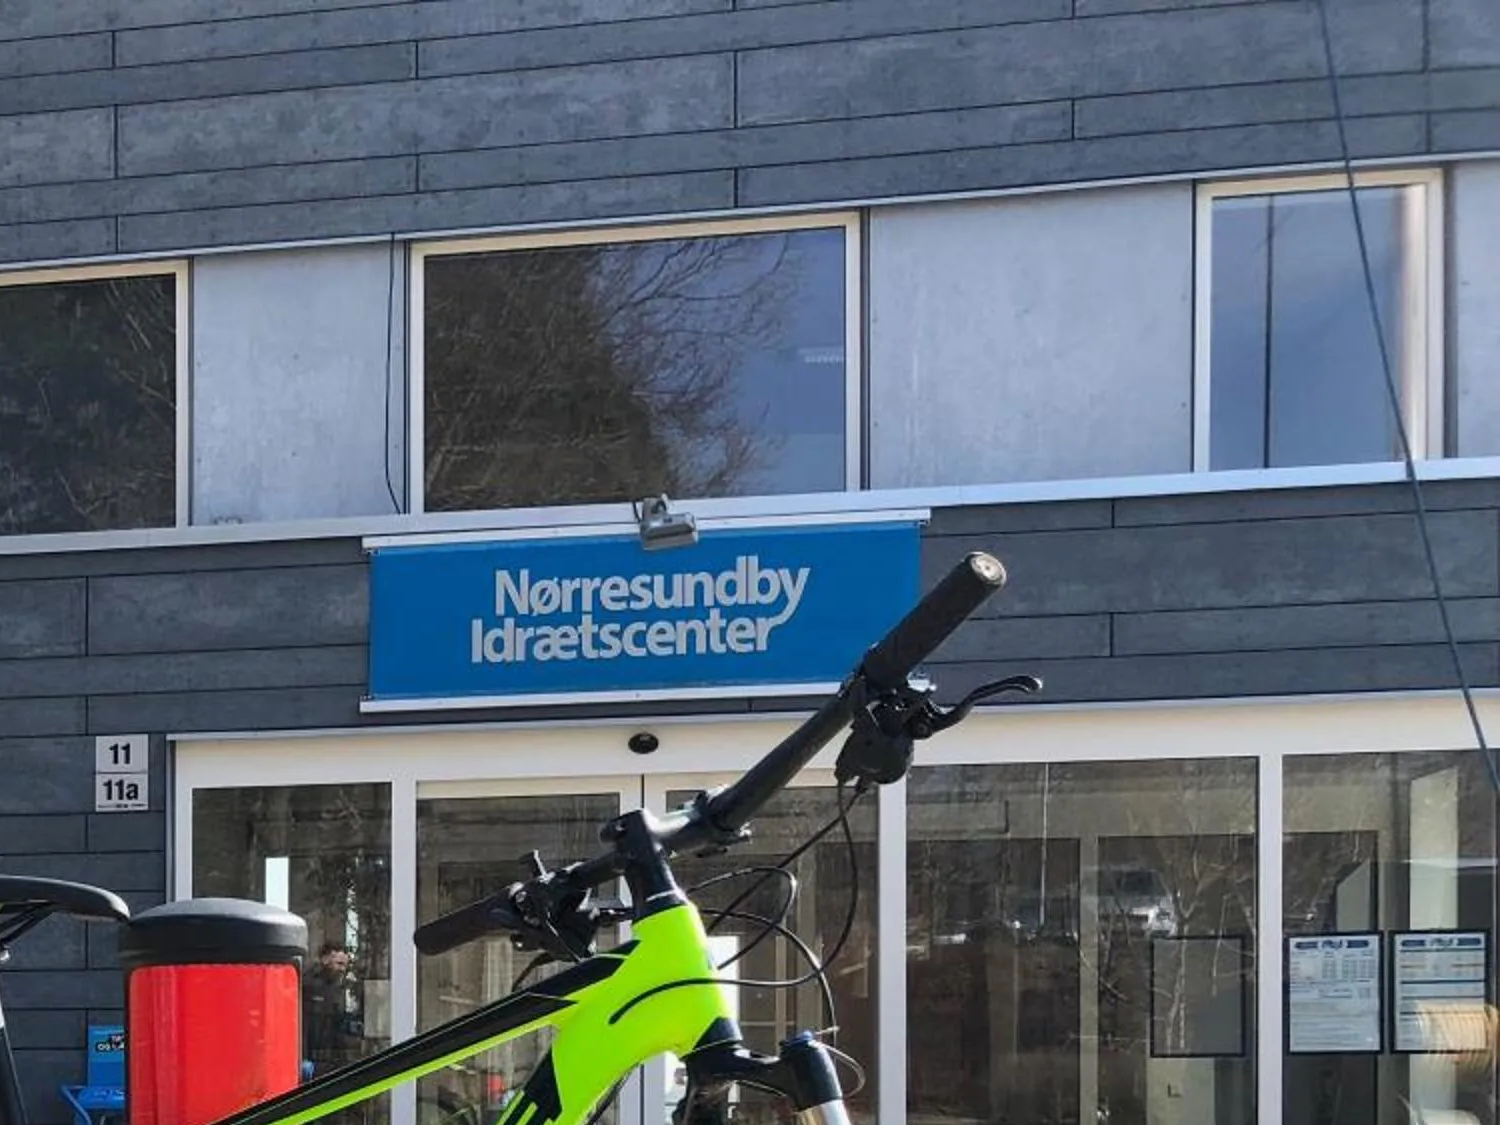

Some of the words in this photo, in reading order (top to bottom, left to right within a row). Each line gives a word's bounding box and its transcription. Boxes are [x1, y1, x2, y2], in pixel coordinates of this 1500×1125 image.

[494, 554, 811, 626] Nørresundby
[471, 608, 778, 664] Idrætscenter
[108, 742, 131, 765] 11
[102, 778, 139, 801] 11a
